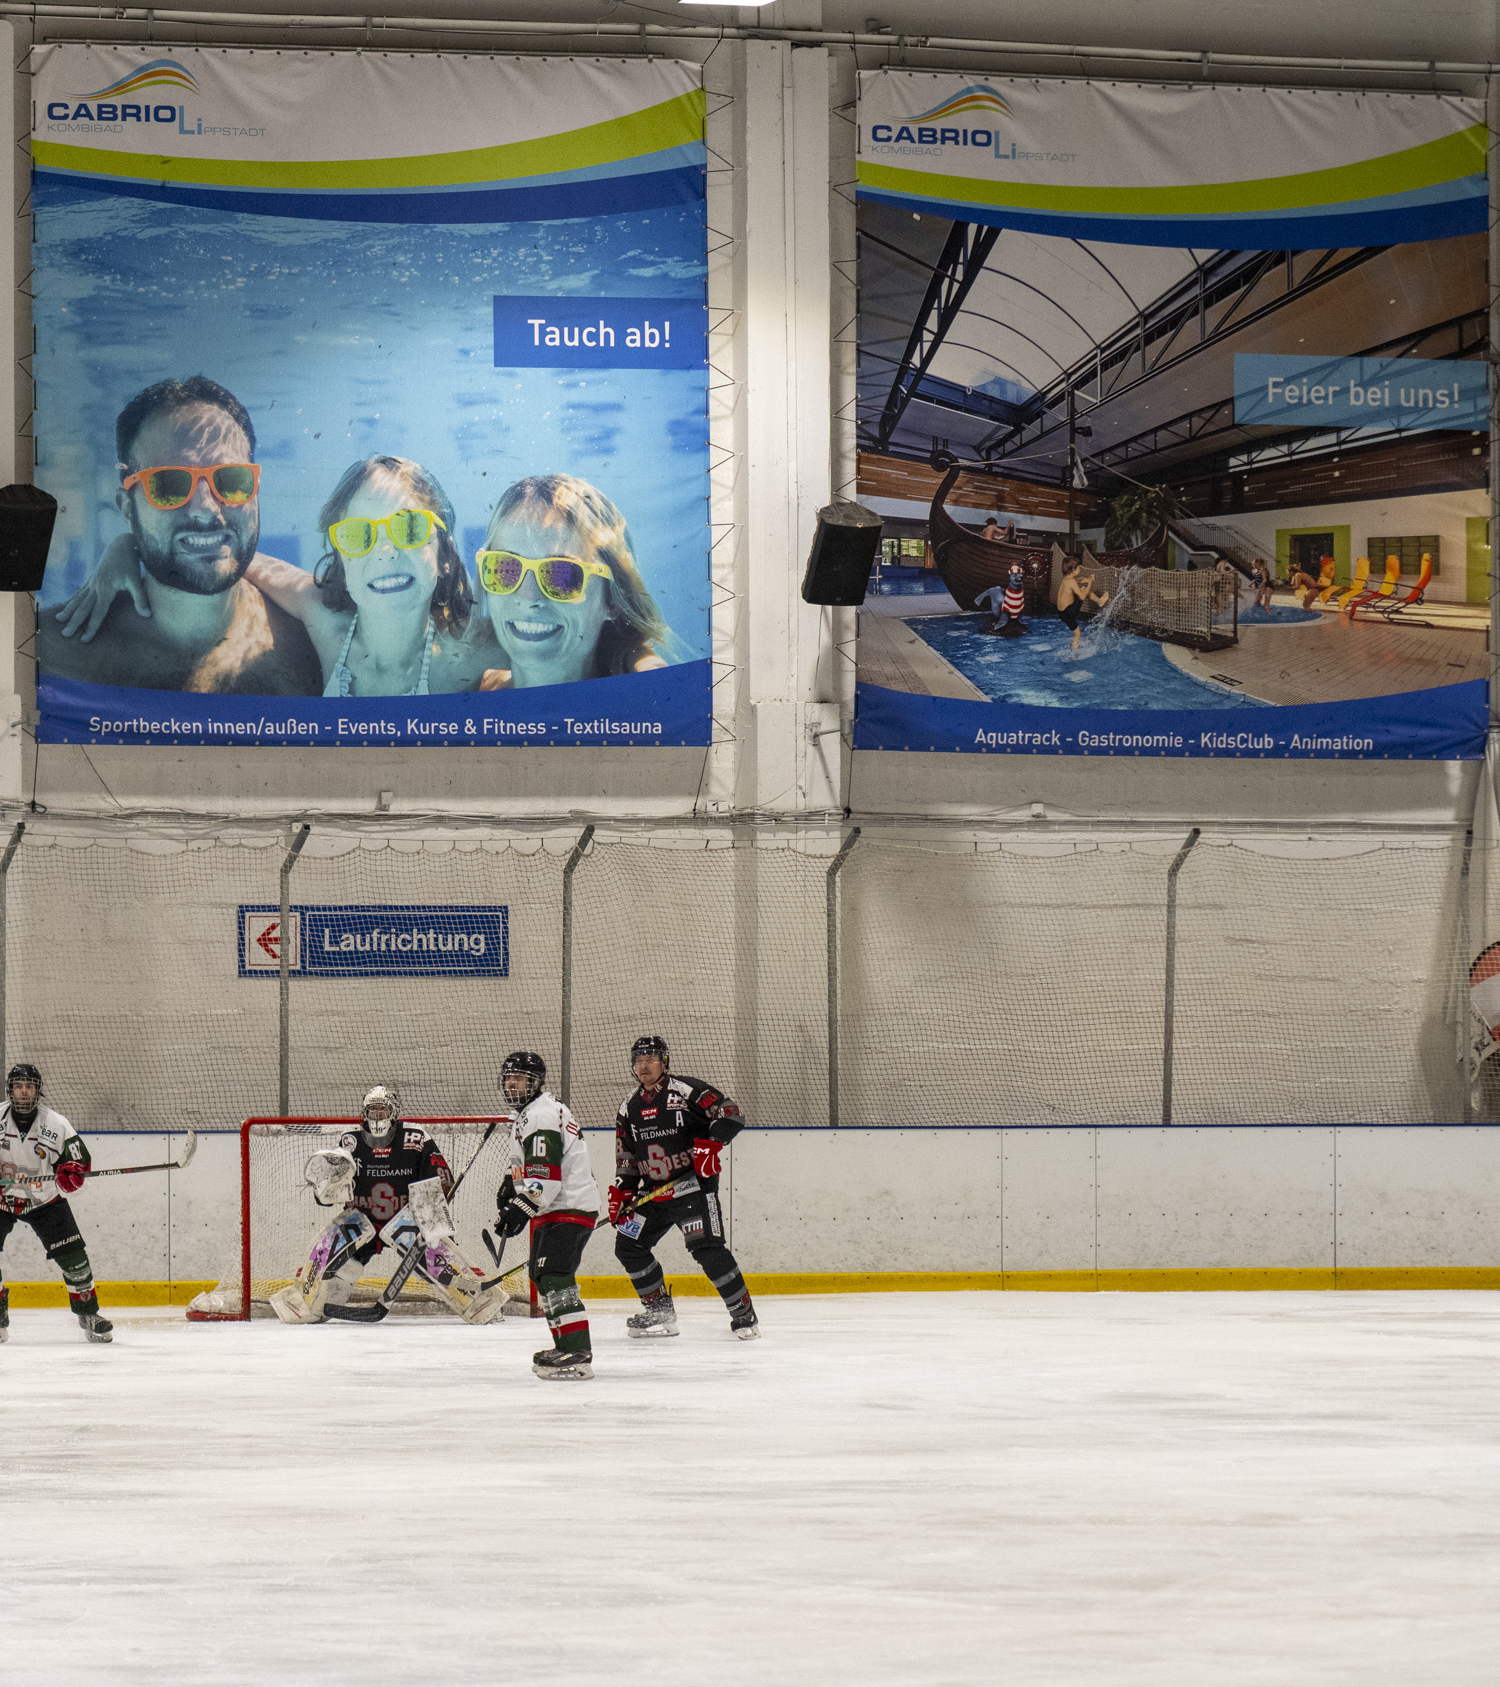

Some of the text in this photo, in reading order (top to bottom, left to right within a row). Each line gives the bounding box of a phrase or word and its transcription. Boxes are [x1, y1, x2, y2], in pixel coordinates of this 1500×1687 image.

[46, 122, 124, 134] KOMBIBAD
[871, 145, 943, 157] KOMBIBAD
[527, 319, 671, 348] Tauch ab!
[1267, 376, 1460, 409] Feier bei uns!
[88, 716, 203, 739] Sportbecken
[207, 717, 319, 736] innen/außen
[337, 719, 401, 738] Events,
[407, 719, 458, 735] Kurse
[464, 719, 478, 735] &
[482, 718, 547, 735] Fitness
[564, 719, 662, 735] Textilsauna
[974, 728, 1061, 748] Aquatrack
[1078, 730, 1183, 748] Gastronomie
[1200, 732, 1274, 749] KidsClub
[1290, 733, 1373, 751] Animation
[323, 927, 486, 956] Laufrichtung
[675, 1110, 684, 1127] A
[640, 1128, 679, 1141] FELDMANN
[532, 1136, 547, 1157] 16
[366, 1168, 413, 1177] FELDMANN
